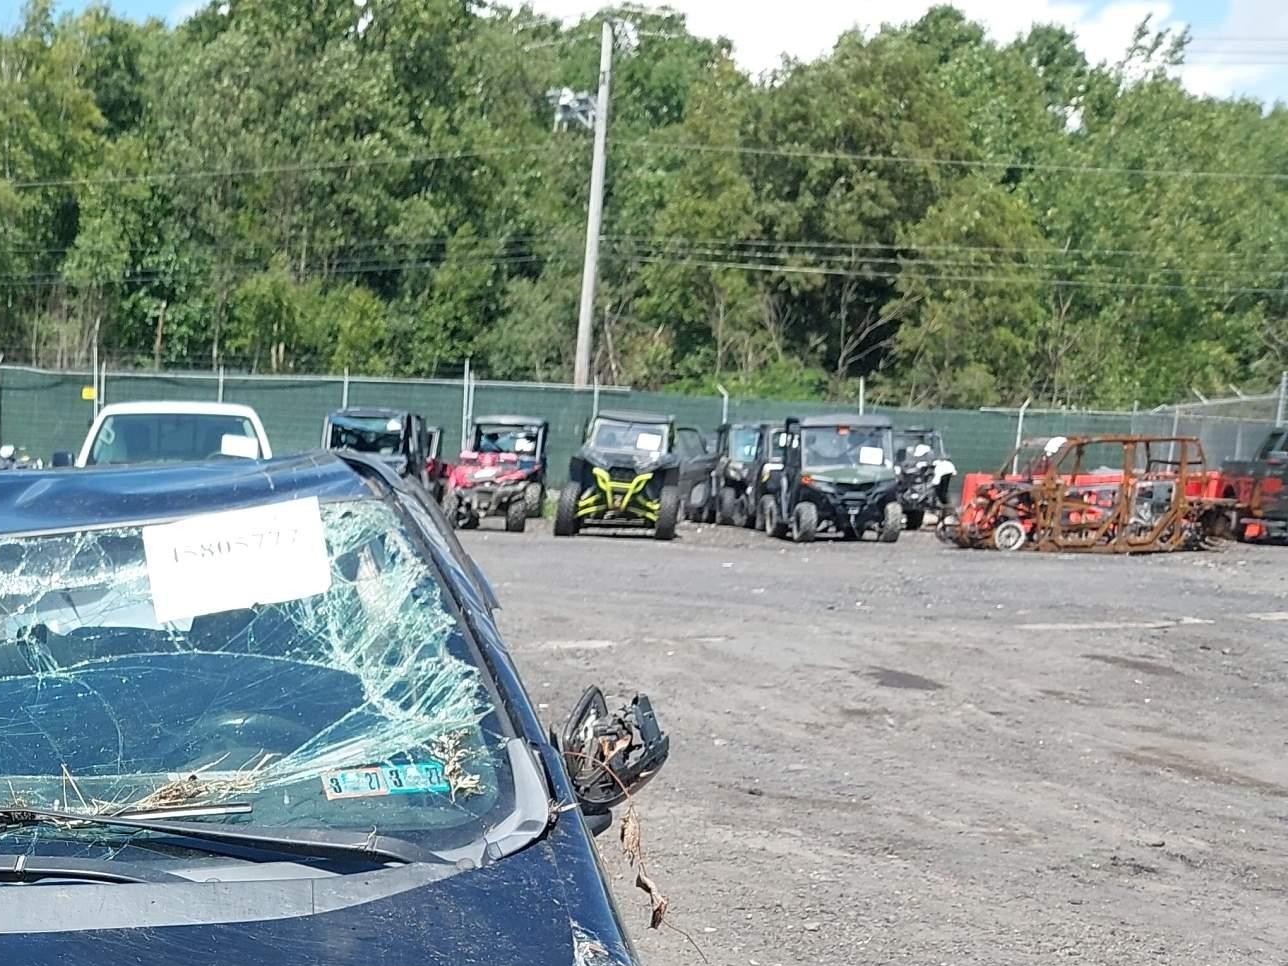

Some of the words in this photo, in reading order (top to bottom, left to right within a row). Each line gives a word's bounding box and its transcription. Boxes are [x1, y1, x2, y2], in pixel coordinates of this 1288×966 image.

[329, 777, 343, 794] 3
[364, 772, 381, 791] 27
[389, 769, 404, 788] 3
